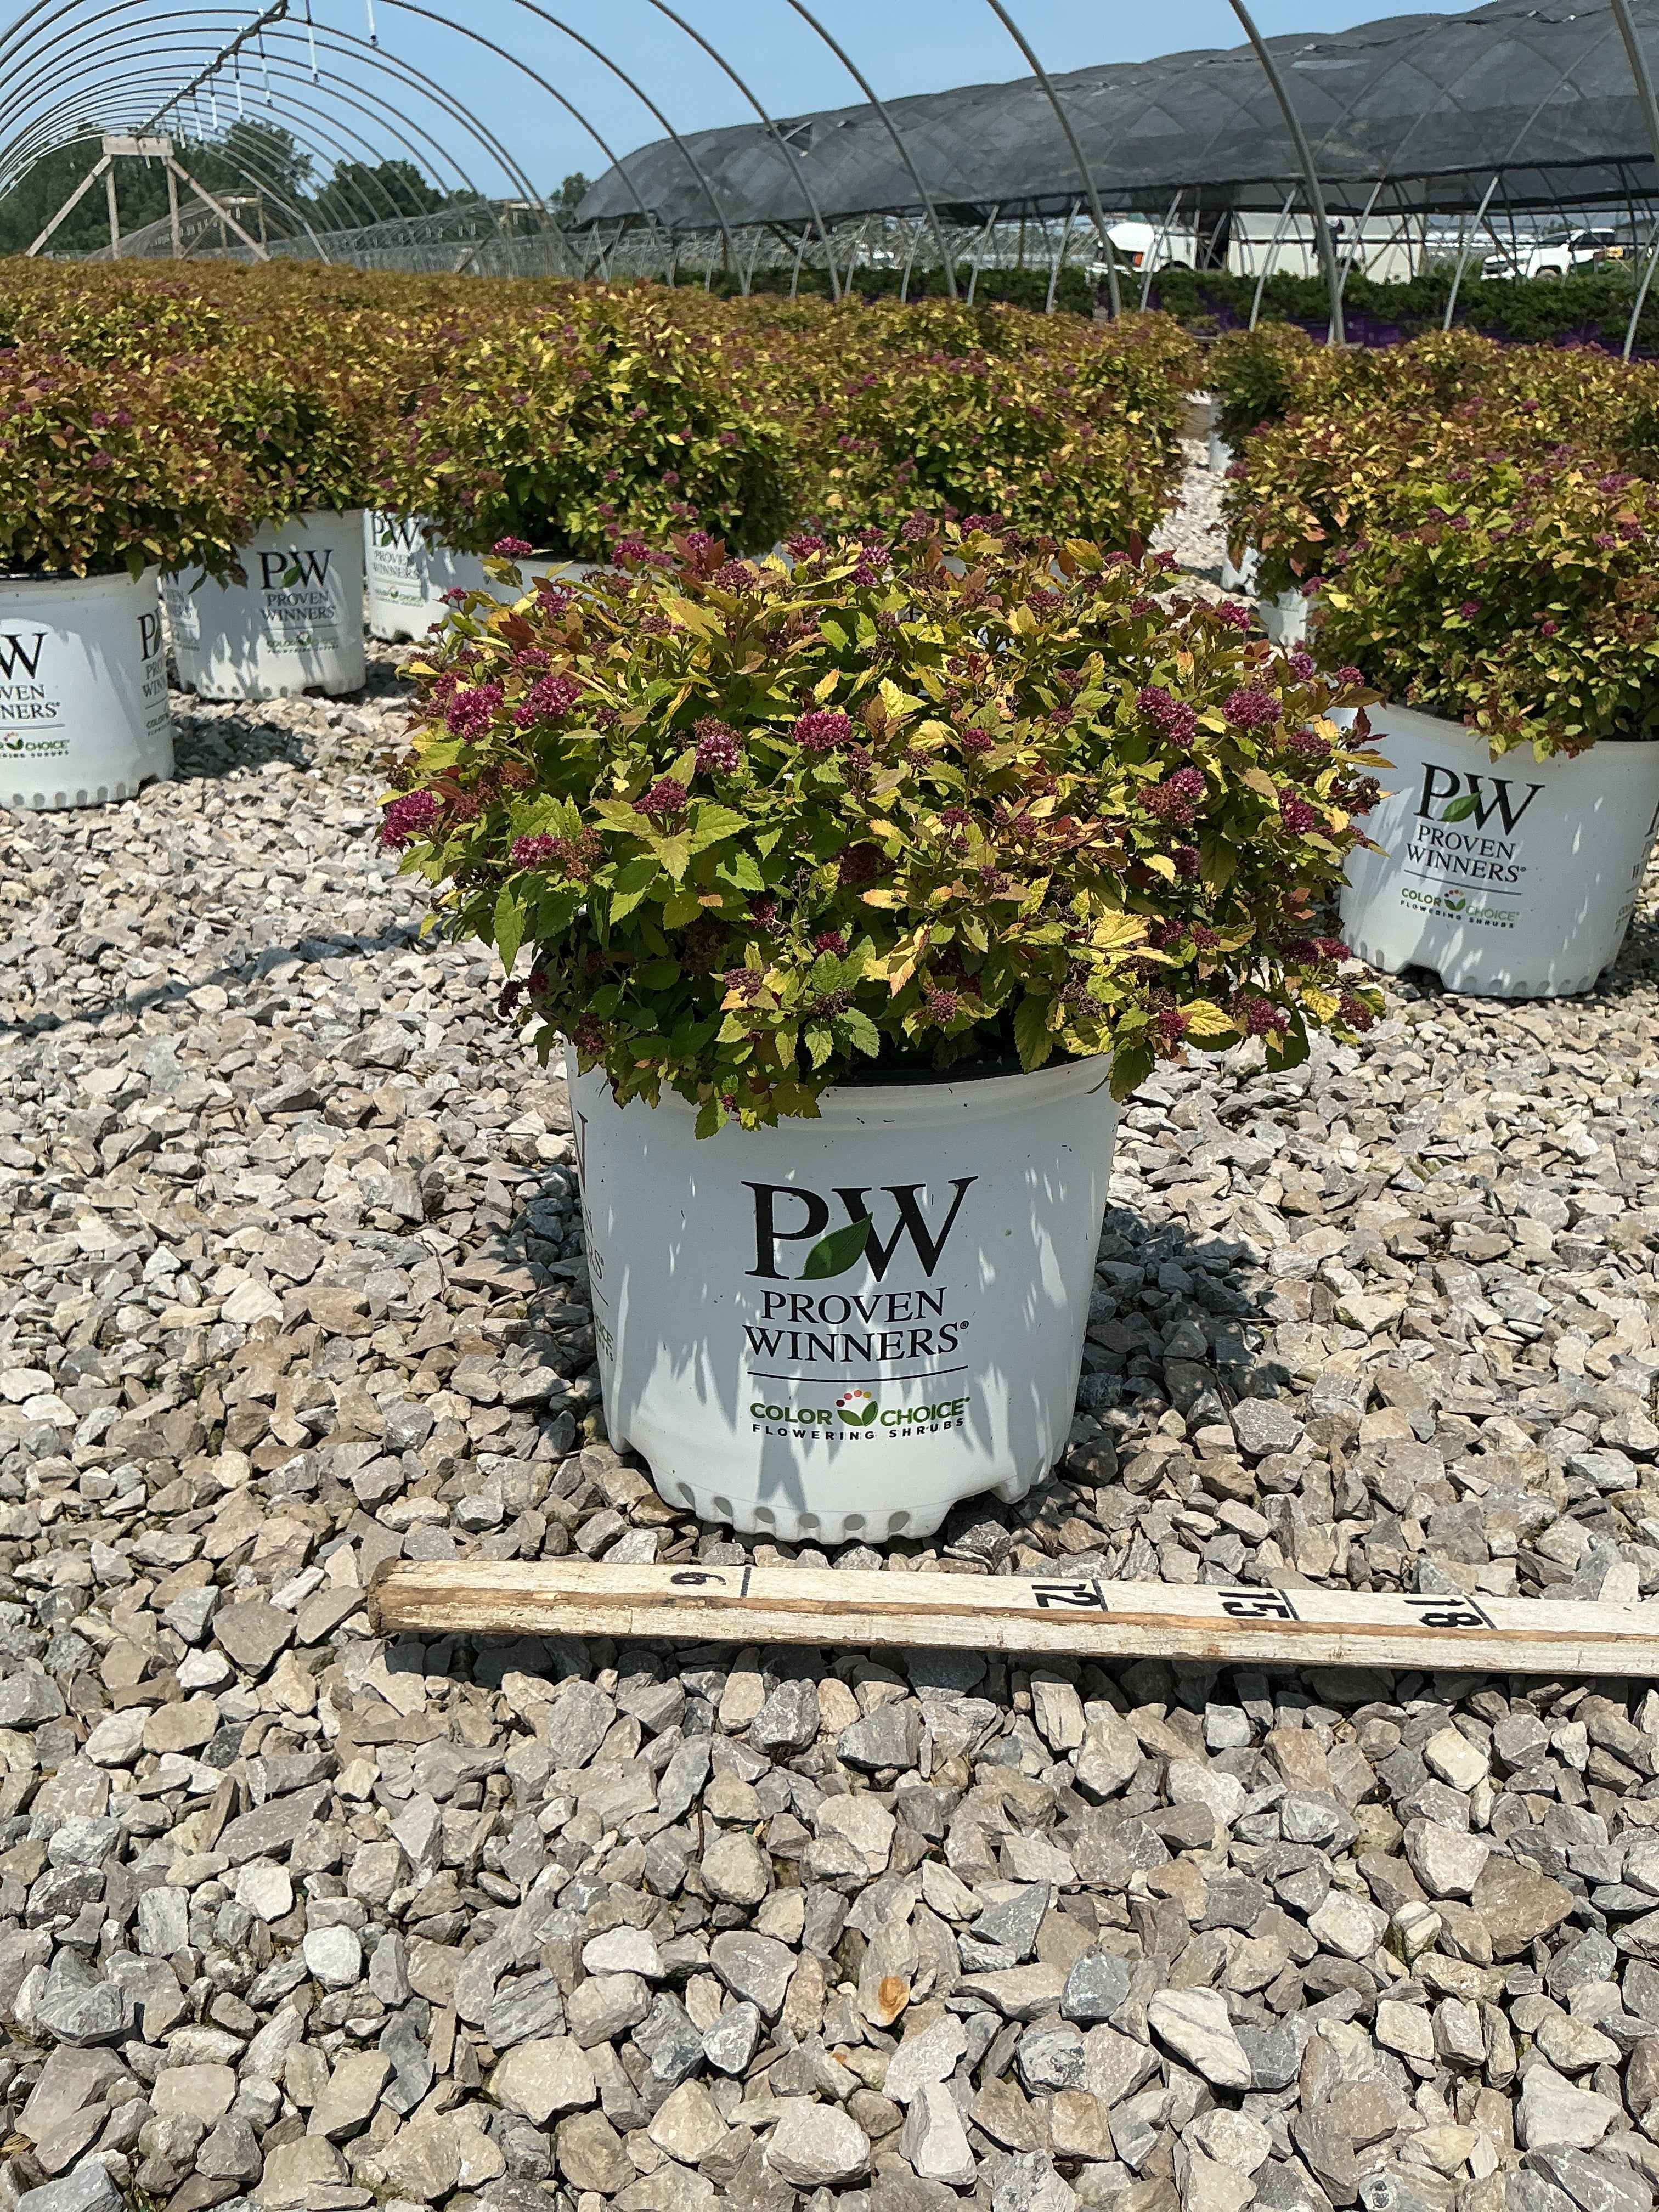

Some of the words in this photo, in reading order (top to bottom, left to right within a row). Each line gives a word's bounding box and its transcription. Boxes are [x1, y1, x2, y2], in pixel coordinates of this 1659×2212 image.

[257, 549, 334, 589] PW
[266, 591, 329, 606] PROVEN
[0, 684, 45, 701] VEN
[0, 701, 57, 720] NERS
[1413, 762, 1545, 837] PW
[1417, 824, 1516, 860] PROVEN
[1401, 888, 1442, 907] COLOR
[741, 1175, 979, 1283] PW
[760, 1286, 948, 1324] PROVEN
[749, 1402, 833, 1426] COLOR
[752, 1424, 874, 1440] FLOWERING
[888, 1417, 964, 1438] SHRUBS
[1031, 1583, 1101, 1608] 12
[1217, 1591, 1291, 1619] 15
[1402, 1598, 1483, 1628] 18
